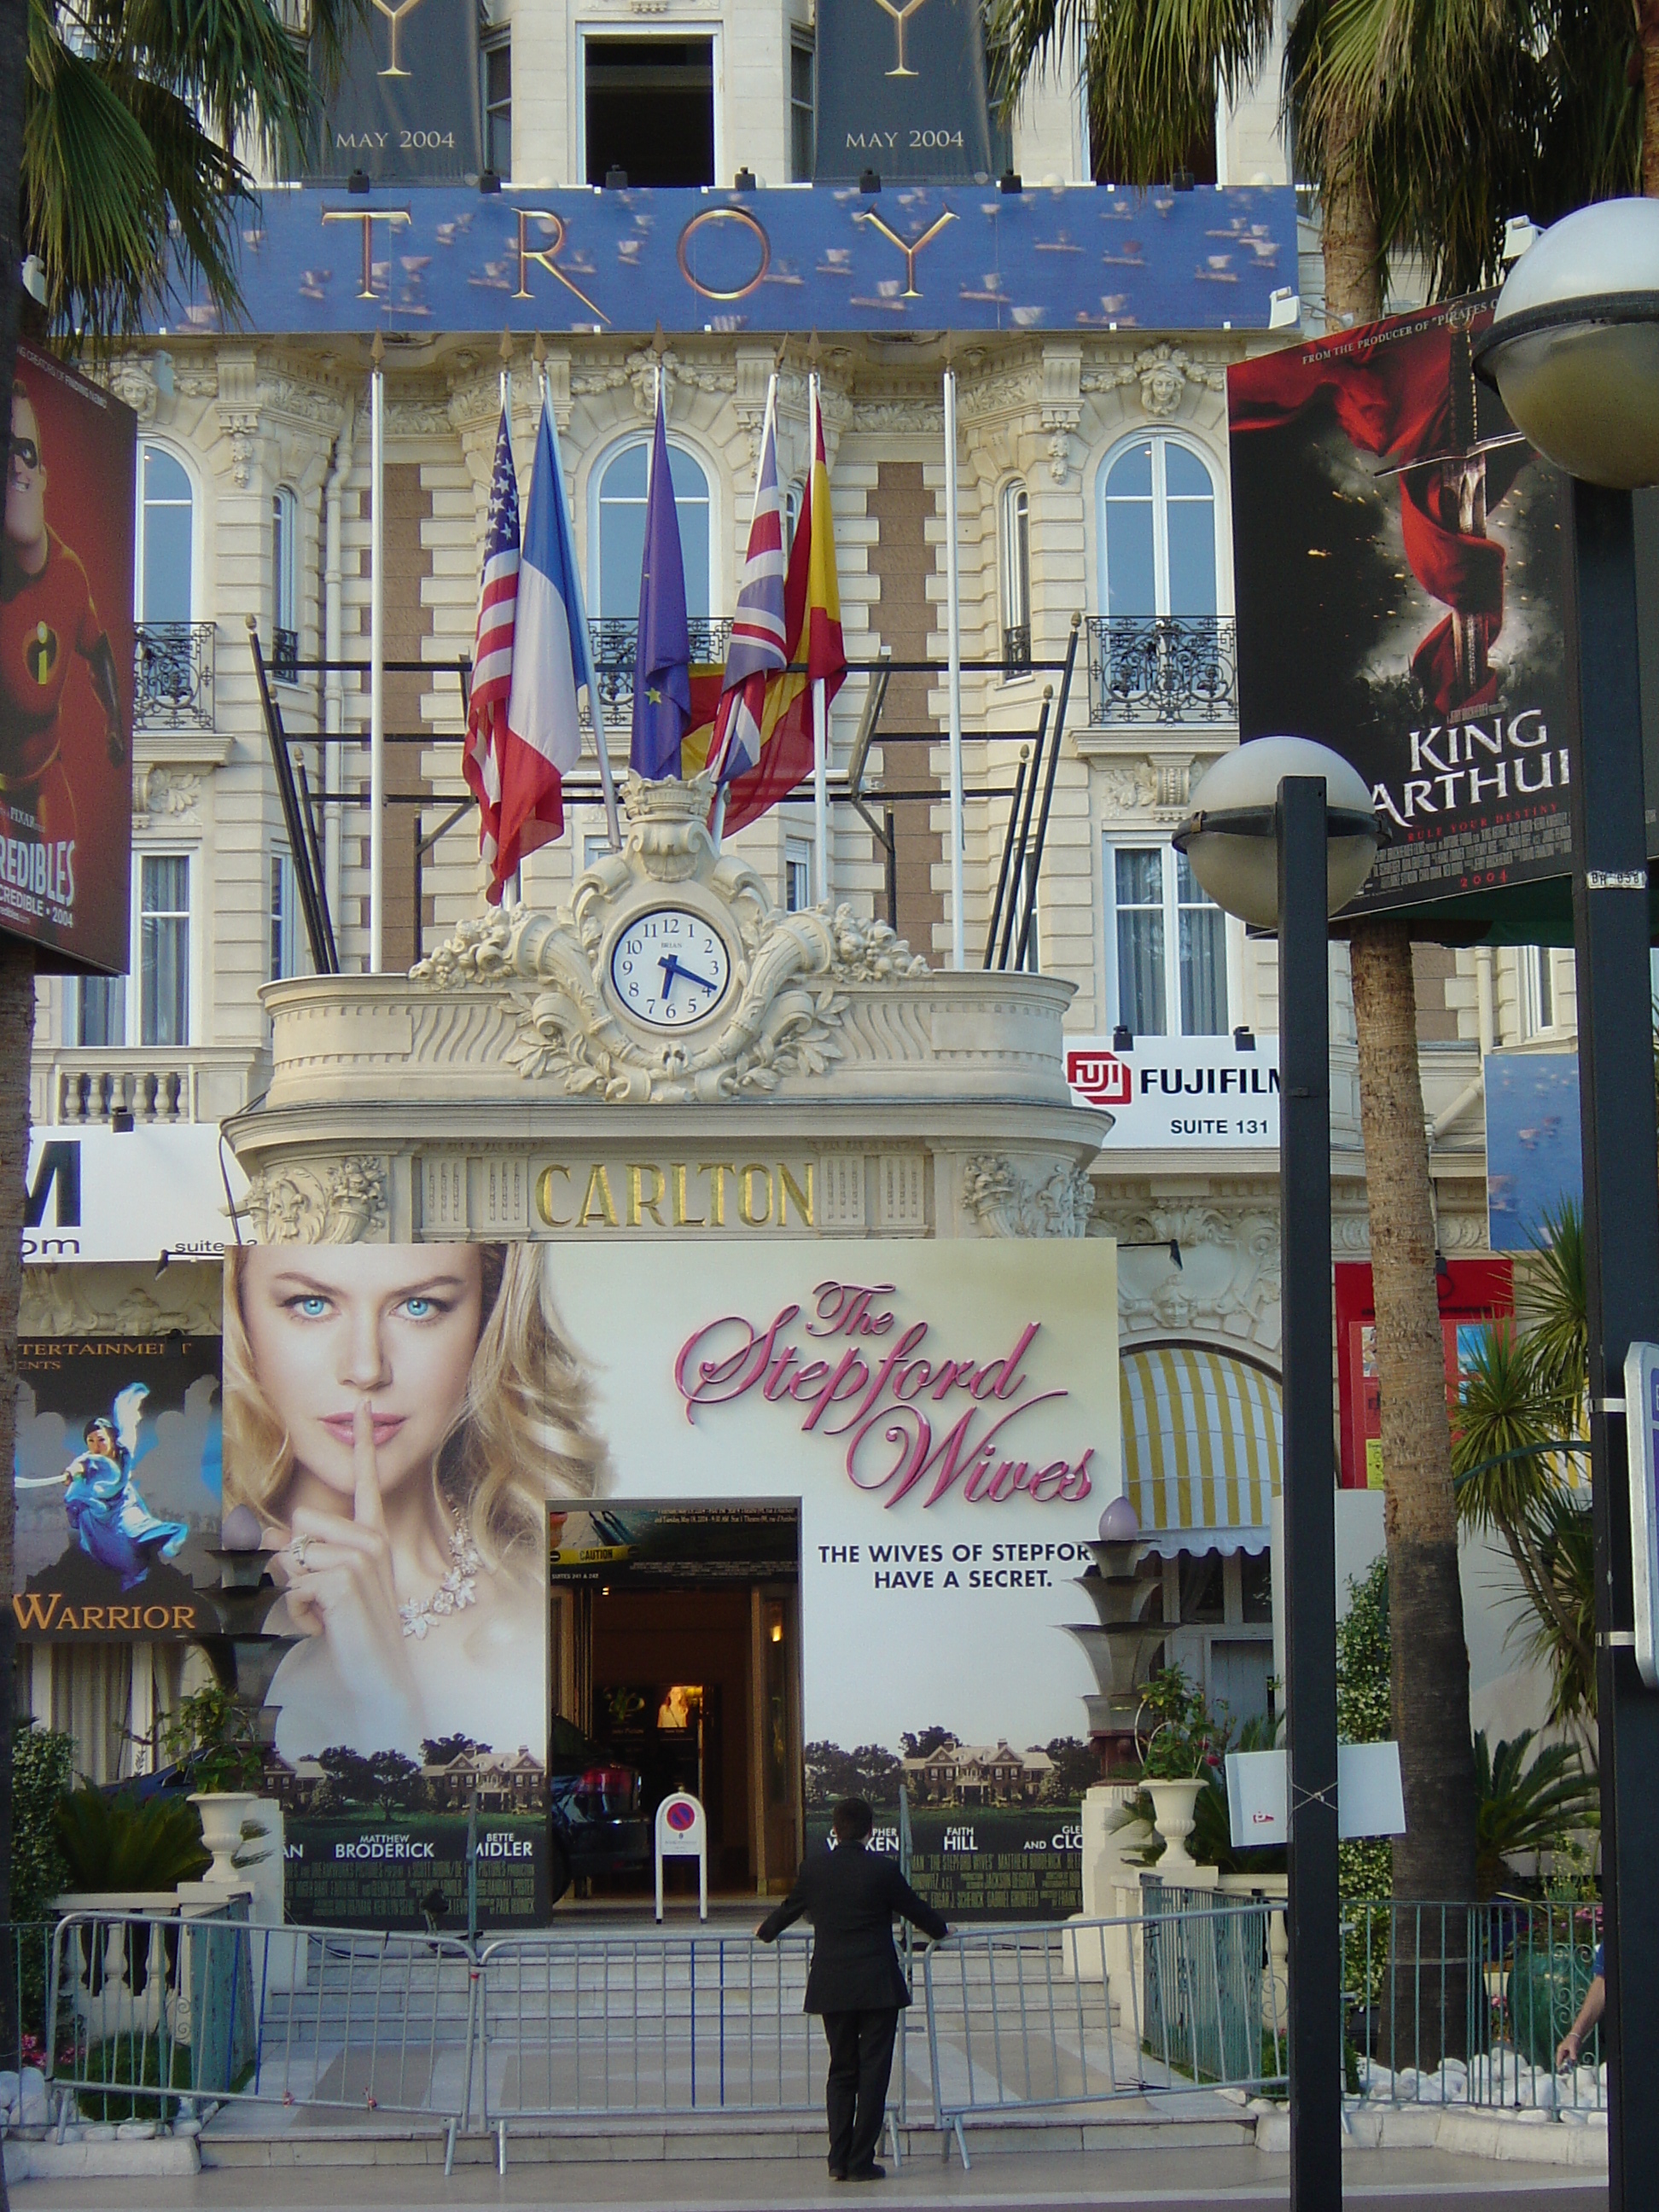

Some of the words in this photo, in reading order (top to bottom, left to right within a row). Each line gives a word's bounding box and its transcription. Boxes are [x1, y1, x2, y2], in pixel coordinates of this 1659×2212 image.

[335, 131, 387, 149] MAY
[399, 129, 457, 149] 2004
[846, 131, 899, 148] MAY
[908, 129, 964, 148] 2004
[321, 202, 960, 324] TROY
[1301, 348, 1332, 365] FROM
[1333, 342, 1354, 356] THE
[1357, 324, 1413, 350] PRODUCER
[1414, 319, 1430, 334] OF
[1409, 708, 1547, 772] KING
[1408, 826, 1443, 842] RULE
[1451, 818, 1488, 833] YOUR
[1496, 802, 1558, 824] DESTINY
[1459, 868, 1508, 888] 2004
[52, 907, 74, 929] 2004
[662, 918, 680, 934] 12
[643, 923, 658, 938] 11
[687, 923, 695, 938] 1
[626, 939, 643, 955] 10
[703, 939, 713, 954] 2
[622, 960, 633, 975] 9
[709, 960, 719, 975] 3
[628, 981, 639, 997] 8
[646, 998, 655, 1014] 7
[666, 1003, 677, 1018] 6
[687, 998, 697, 1013] 5
[1067, 1051, 1132, 1104] FUJI
[1170, 1119, 1229, 1135] SUITE
[1236, 1120, 1269, 1134] 131
[534, 1163, 814, 1229] CARLTON
[175, 1239, 224, 1253] suite
[805, 1280, 896, 1336] The
[17, 1342, 192, 1356] TERTAINMET
[674, 1303, 1042, 1435] Stepford
[846, 1388, 1096, 1509] Wives
[579, 1549, 614, 1562] CAUTION
[818, 1545, 860, 1563] THE
[868, 1545, 943, 1563] WIVES
[952, 1545, 983, 1563] OF
[992, 1543, 1091, 1562] STEPFOR
[874, 1569, 934, 1589] HAVE
[943, 1569, 960, 1588] A
[968, 1569, 1053, 1588] SECRET.
[13, 1592, 195, 1631] WARRIOR
[486, 1832, 515, 1842] BETTE
[946, 1826, 975, 1836] FAITH
[1062, 1825, 1083, 1835] GLE
[359, 1834, 410, 1844] MATTHEW
[944, 1836, 979, 1851] HILL
[1023, 1840, 1047, 1850] AND
[335, 1842, 435, 1859] BRODERICK
